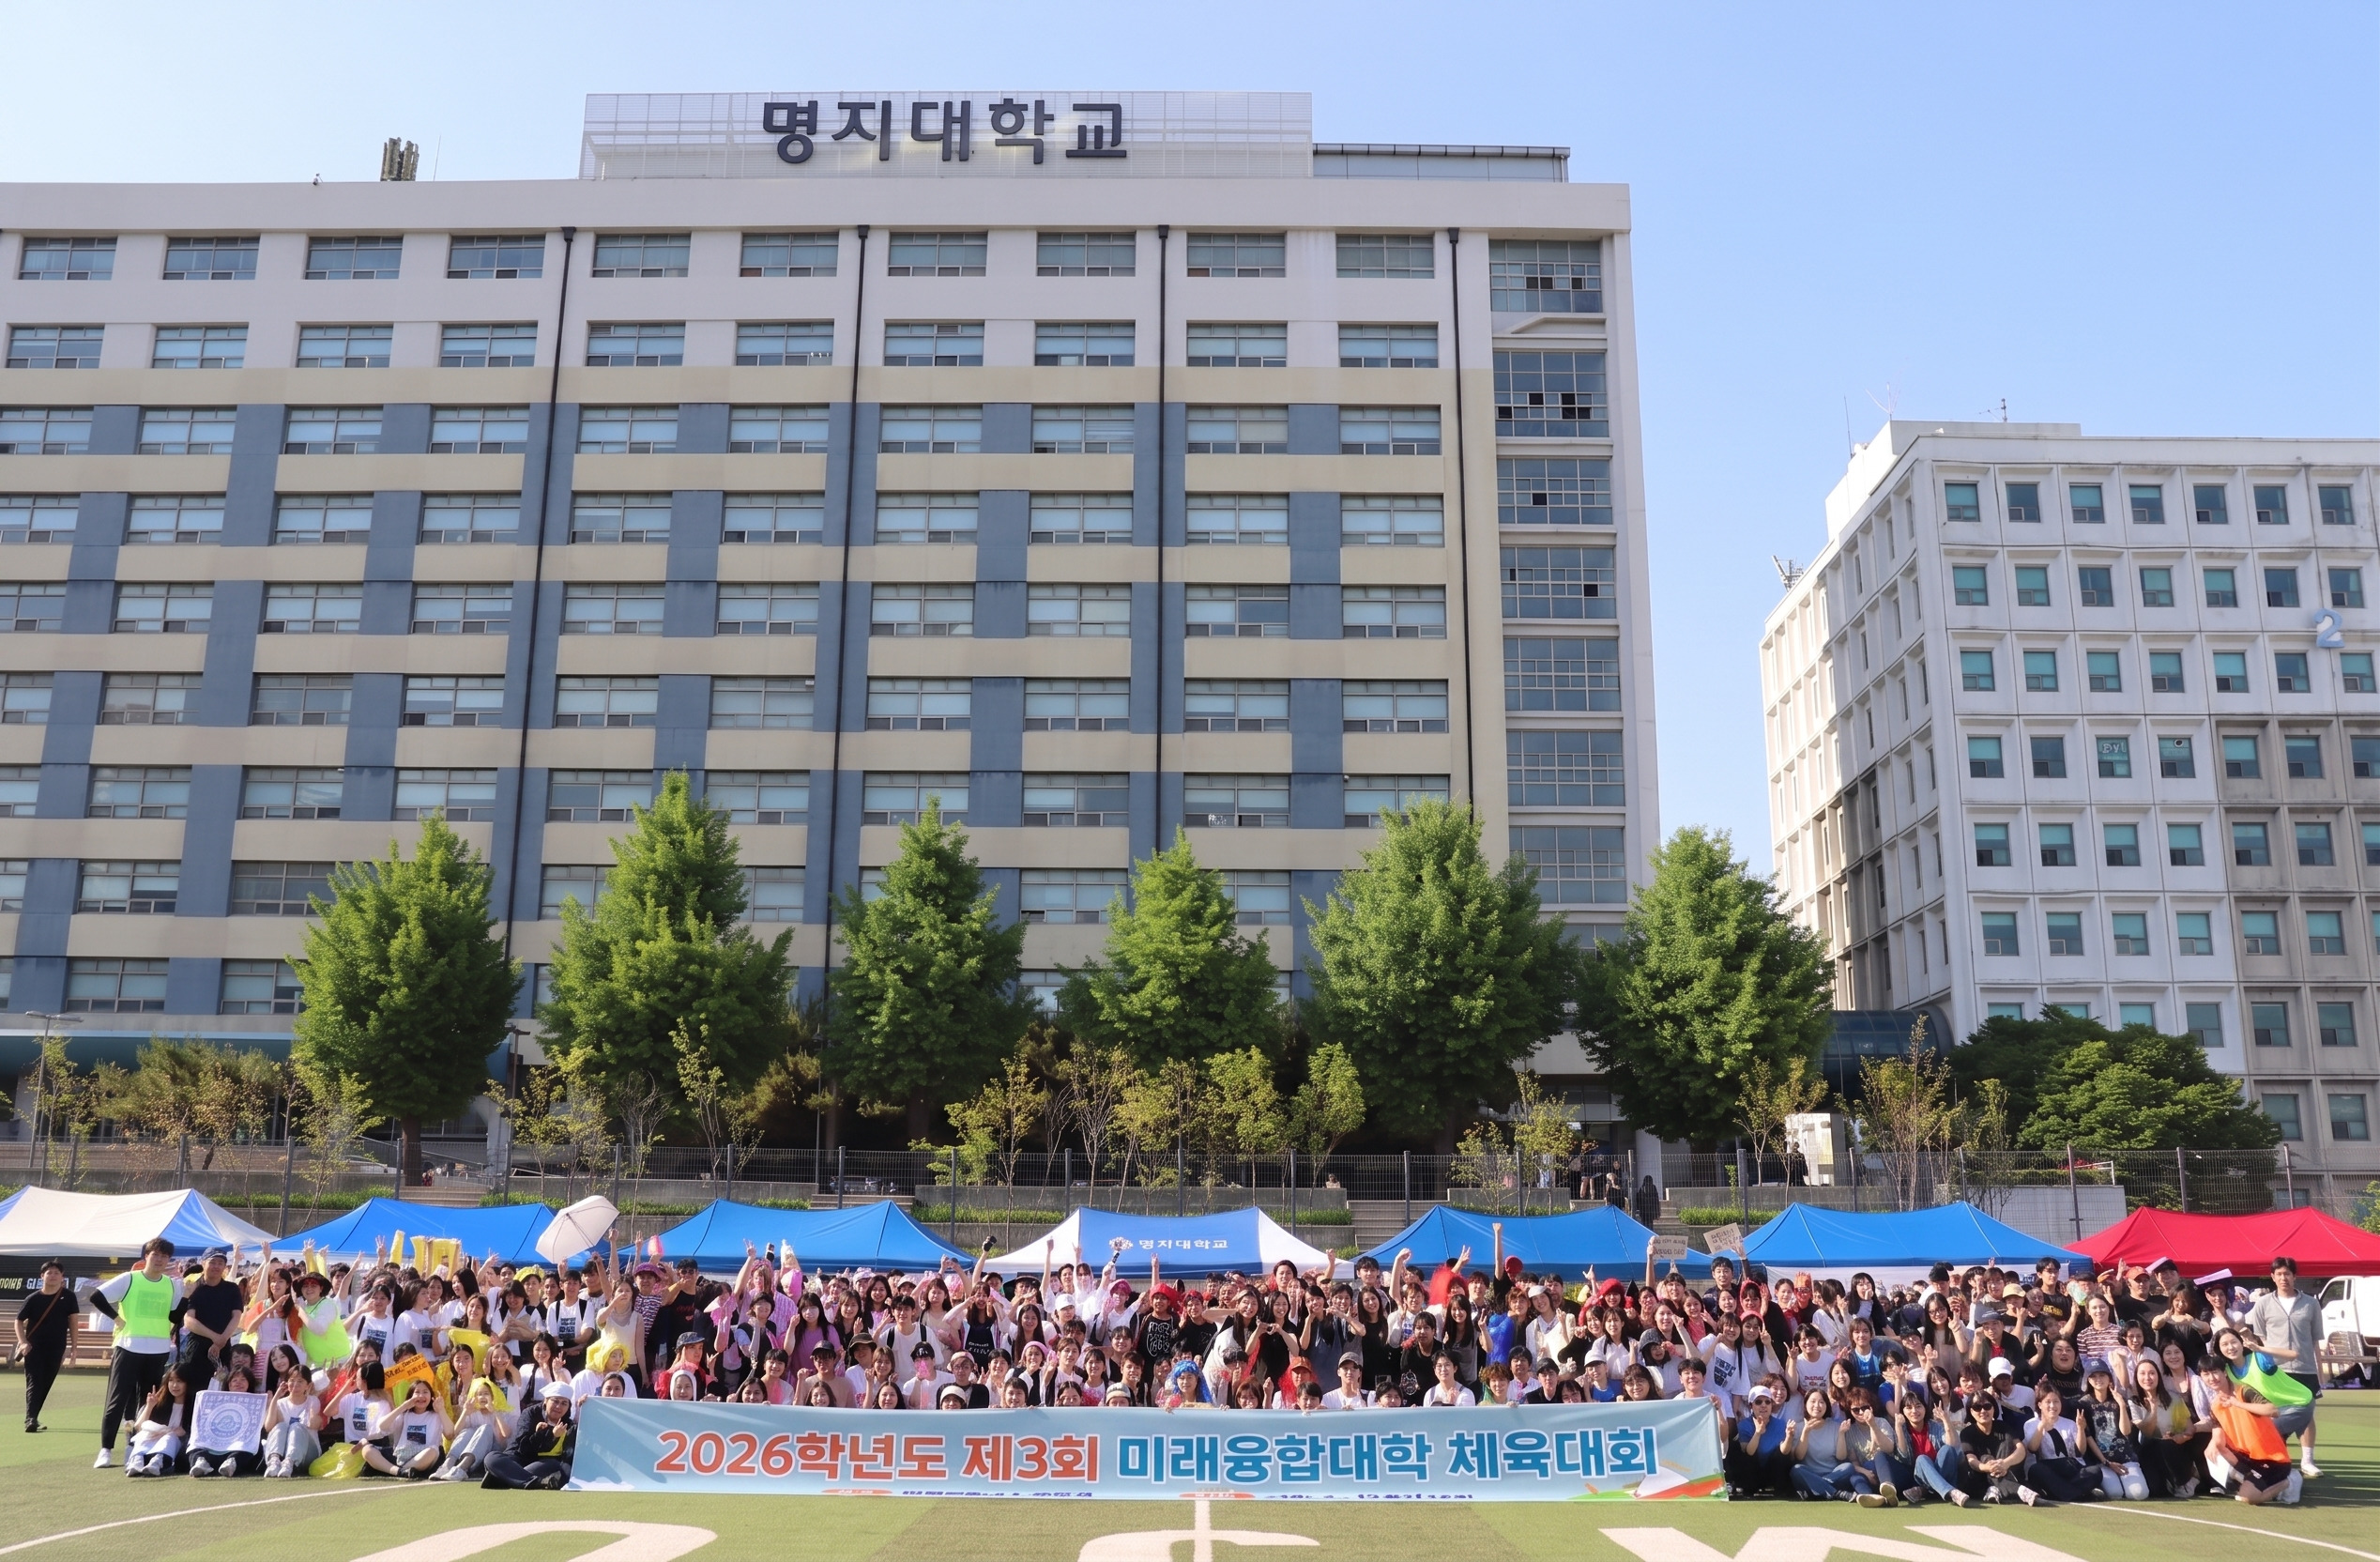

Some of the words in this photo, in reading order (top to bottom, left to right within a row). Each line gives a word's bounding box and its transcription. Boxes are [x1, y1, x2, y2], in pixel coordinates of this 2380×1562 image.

[762, 98, 1127, 165] 명지대학교
[2312, 607, 2345, 648] 2
[1138, 1239, 1228, 1249] 명지대학교
[654, 1429, 948, 1481] 2026학년도
[961, 1433, 1100, 1483] 제3회
[1117, 1429, 1433, 1485] 미래융합대학
[1444, 1426, 1661, 1481] 체육대회
